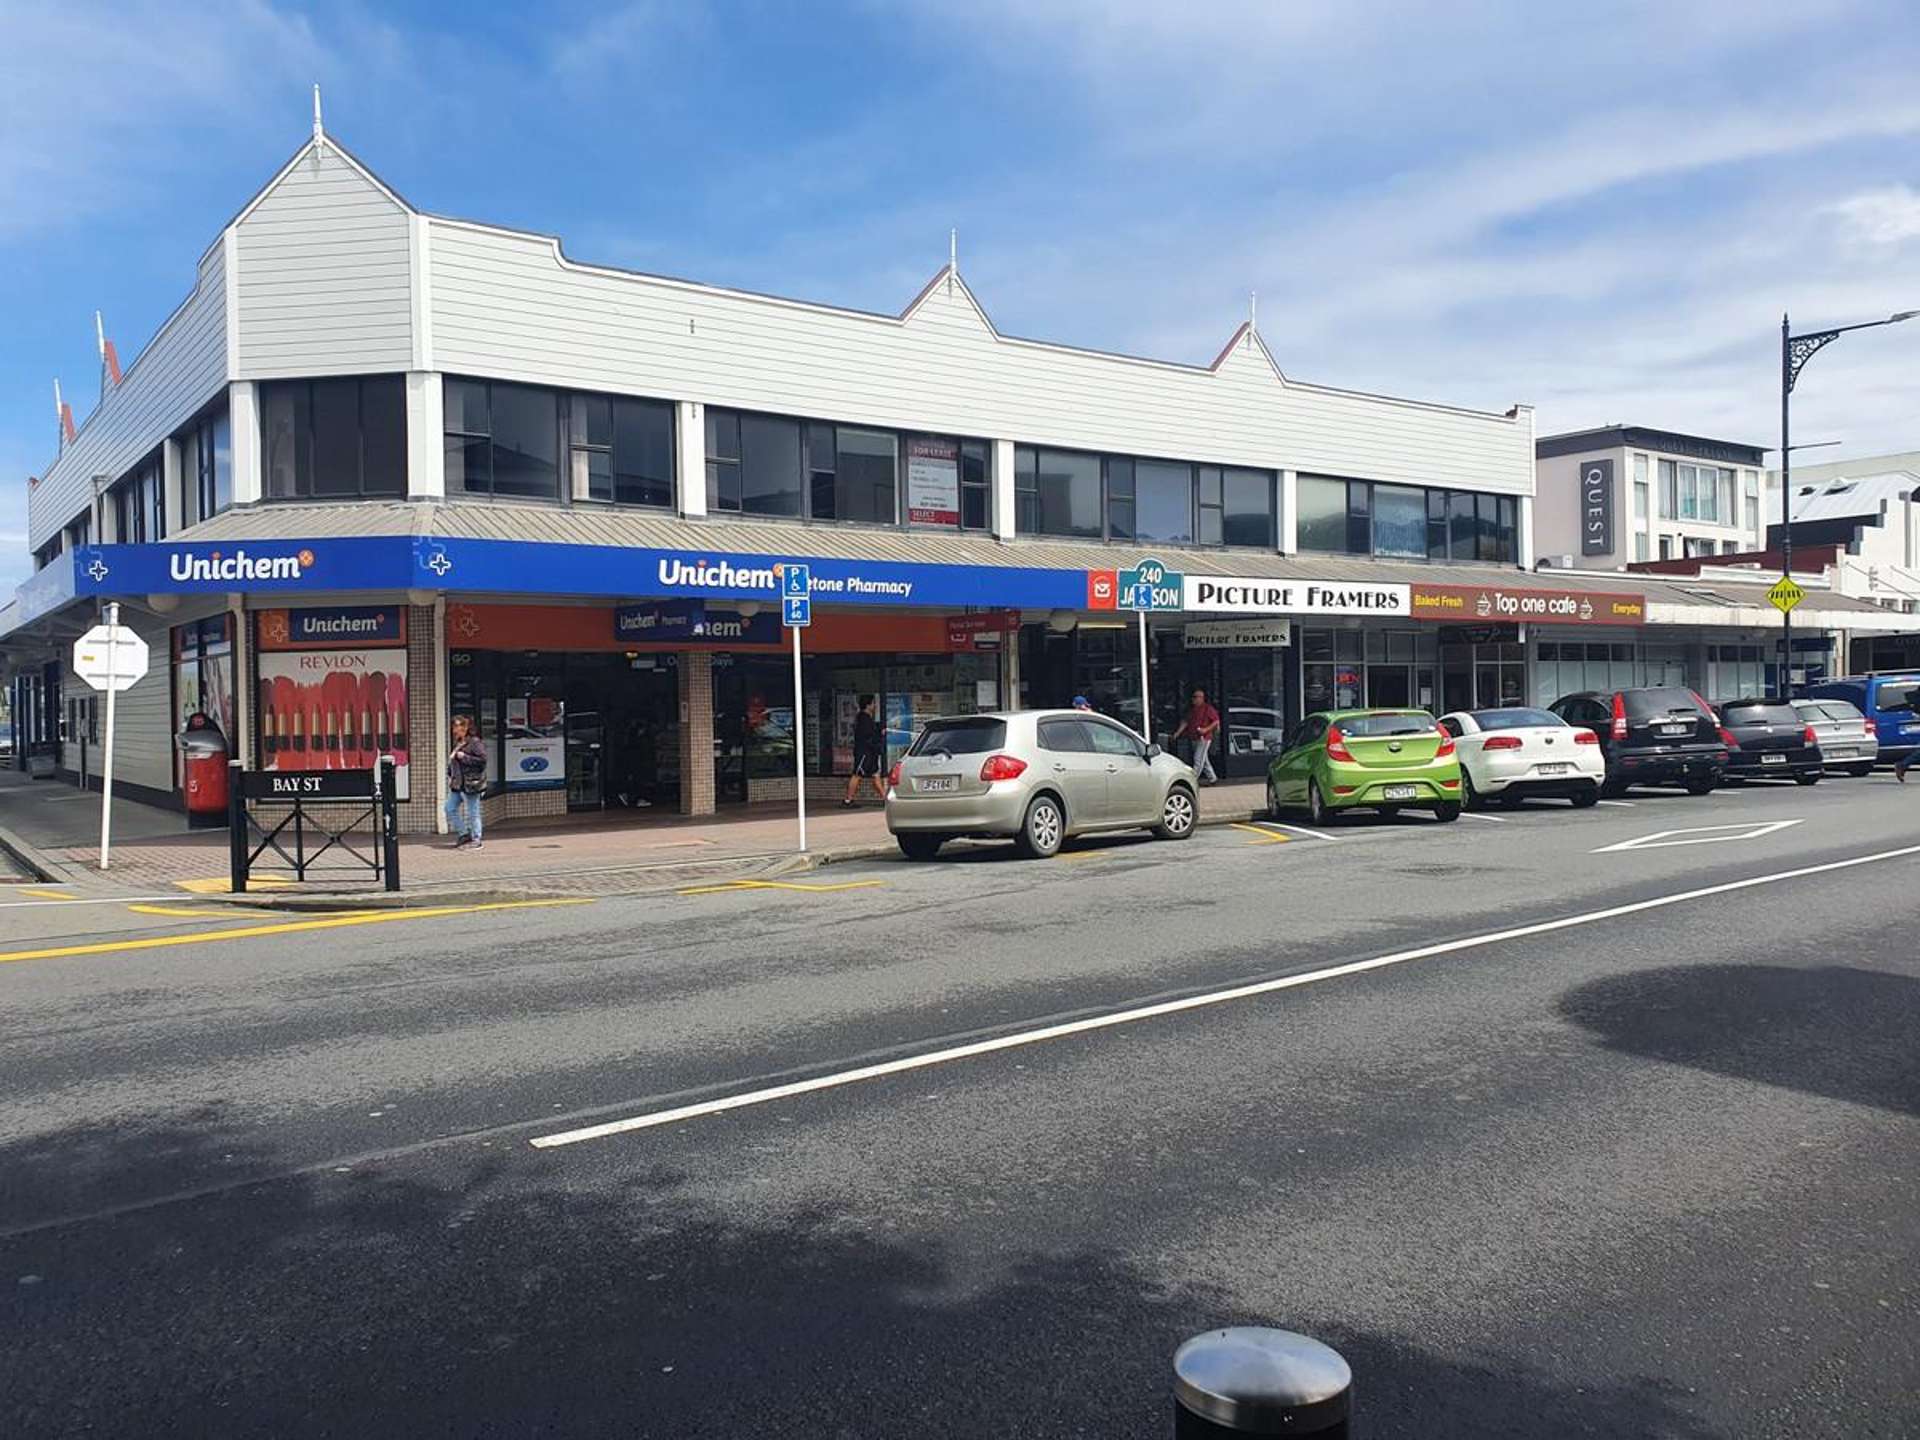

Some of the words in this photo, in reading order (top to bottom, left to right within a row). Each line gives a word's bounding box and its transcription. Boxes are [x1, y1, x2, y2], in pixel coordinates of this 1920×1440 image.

[1585, 469, 1604, 547] QUEST
[170, 550, 301, 580] Unichem
[659, 559, 776, 589] Unichem
[807, 578, 844, 592] etone
[847, 577, 912, 597] Pharmacy
[1140, 567, 1162, 583] 240
[1121, 586, 1178, 606] JASON
[1198, 583, 1293, 606] PICTURE
[1307, 586, 1399, 609] FRAMERS
[1415, 594, 1440, 606] Baked
[1442, 595, 1463, 608] Fresh
[1496, 592, 1519, 614] Top
[1521, 600, 1546, 612] one
[1549, 595, 1577, 613] cafe
[1612, 603, 1641, 616] Everyday
[303, 615, 378, 633] Unichem
[300, 653, 368, 669] REVLON
[273, 777, 301, 792] BAY
[303, 777, 322, 791] ST
